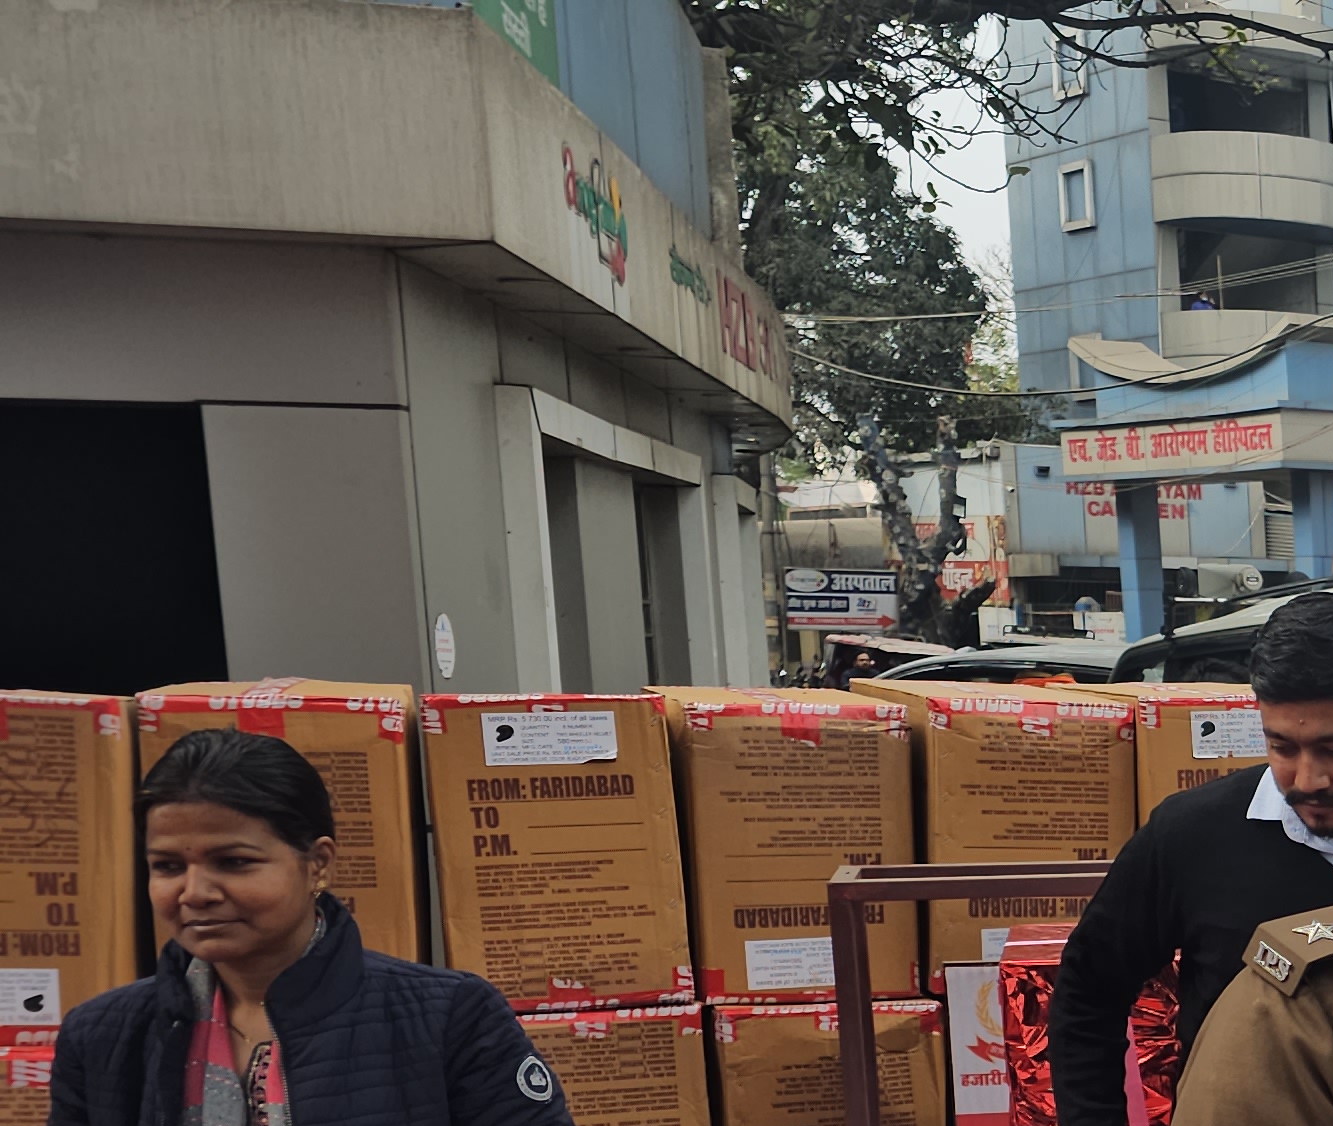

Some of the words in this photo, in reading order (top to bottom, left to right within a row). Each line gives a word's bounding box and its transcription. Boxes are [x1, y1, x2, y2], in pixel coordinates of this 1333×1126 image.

[1067, 437, 1093, 463] एच.
[1094, 430, 1122, 462] जेड.
[1124, 427, 1146, 460] बी.
[1150, 424, 1209, 459] आरोग्यम
[1211, 418, 1273, 454] हॉस्पिटल
[830, 573, 897, 593] अस्पताल
[466, 777, 528, 802] FROM:
[529, 774, 635, 799] FARIDABAD
[470, 806, 500, 829] TO
[473, 834, 518, 858] P.M.
[46, 902, 81, 927] TO
[1253, 940, 1292, 982] IPS
